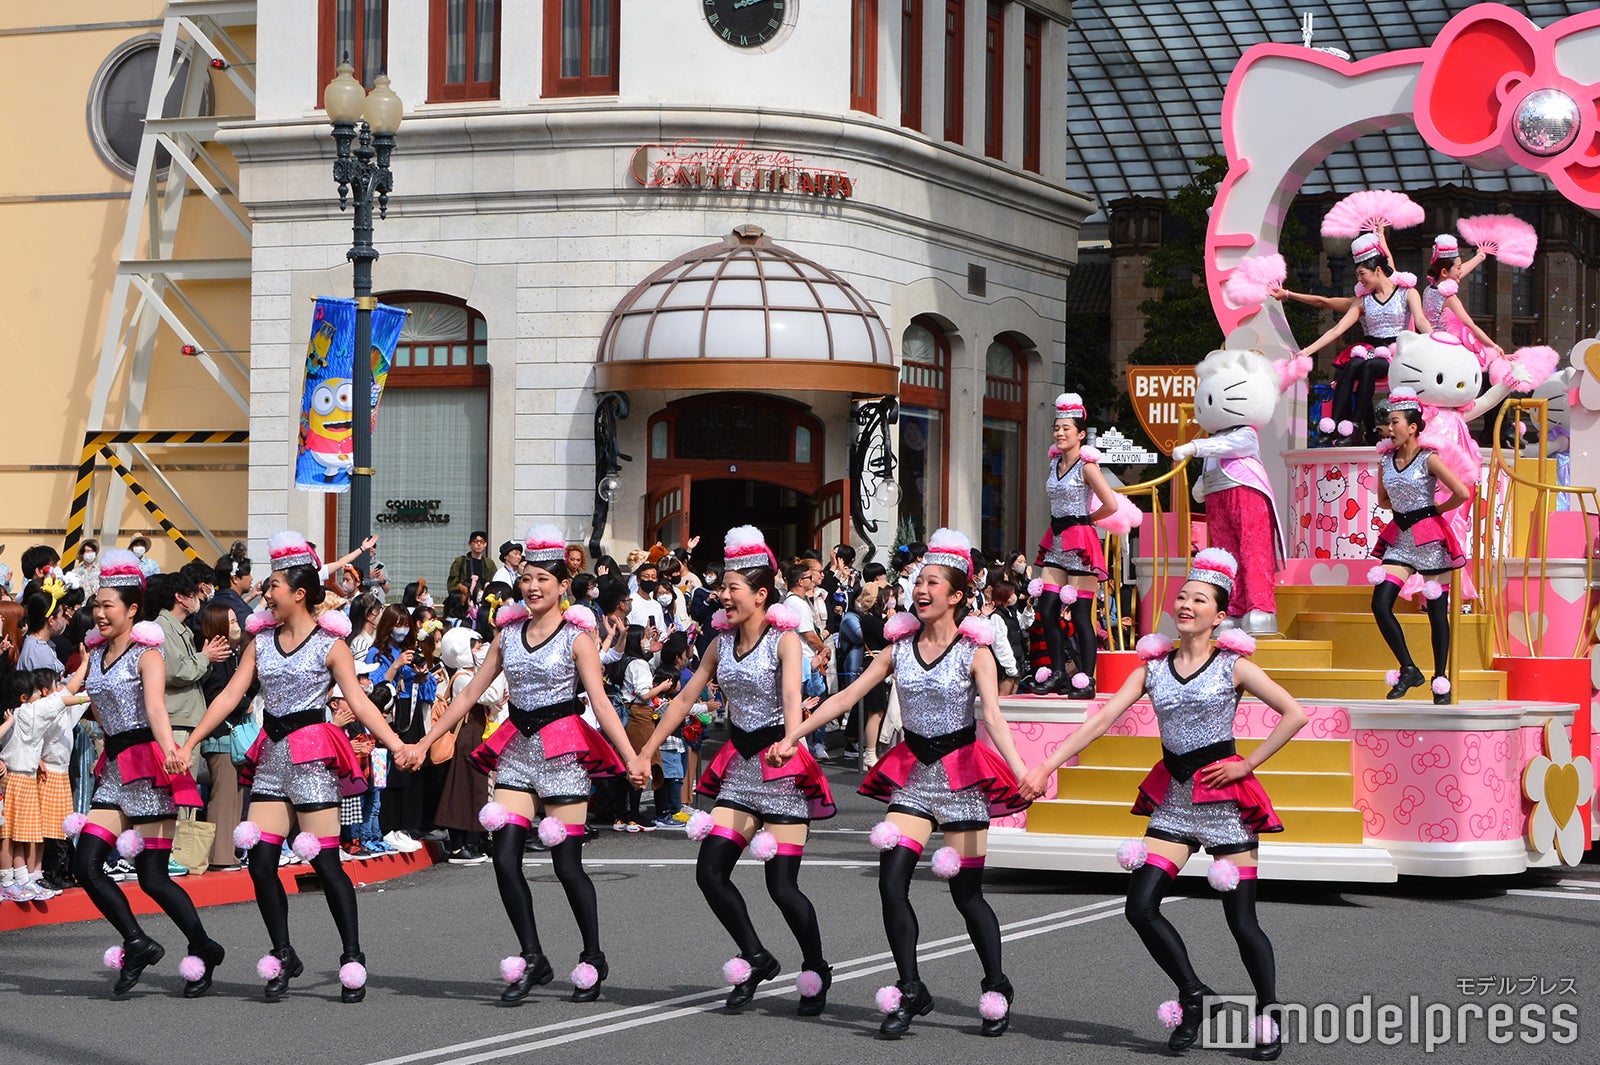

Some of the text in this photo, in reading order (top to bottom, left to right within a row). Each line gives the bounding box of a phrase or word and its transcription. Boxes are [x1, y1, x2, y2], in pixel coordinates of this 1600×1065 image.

[671, 137, 804, 169] California
[1135, 375, 1199, 398] BEVER
[1111, 453, 1141, 463] CANYON
[385, 499, 442, 510] GOURMET
[375, 513, 451, 524] CHOCOLATES
